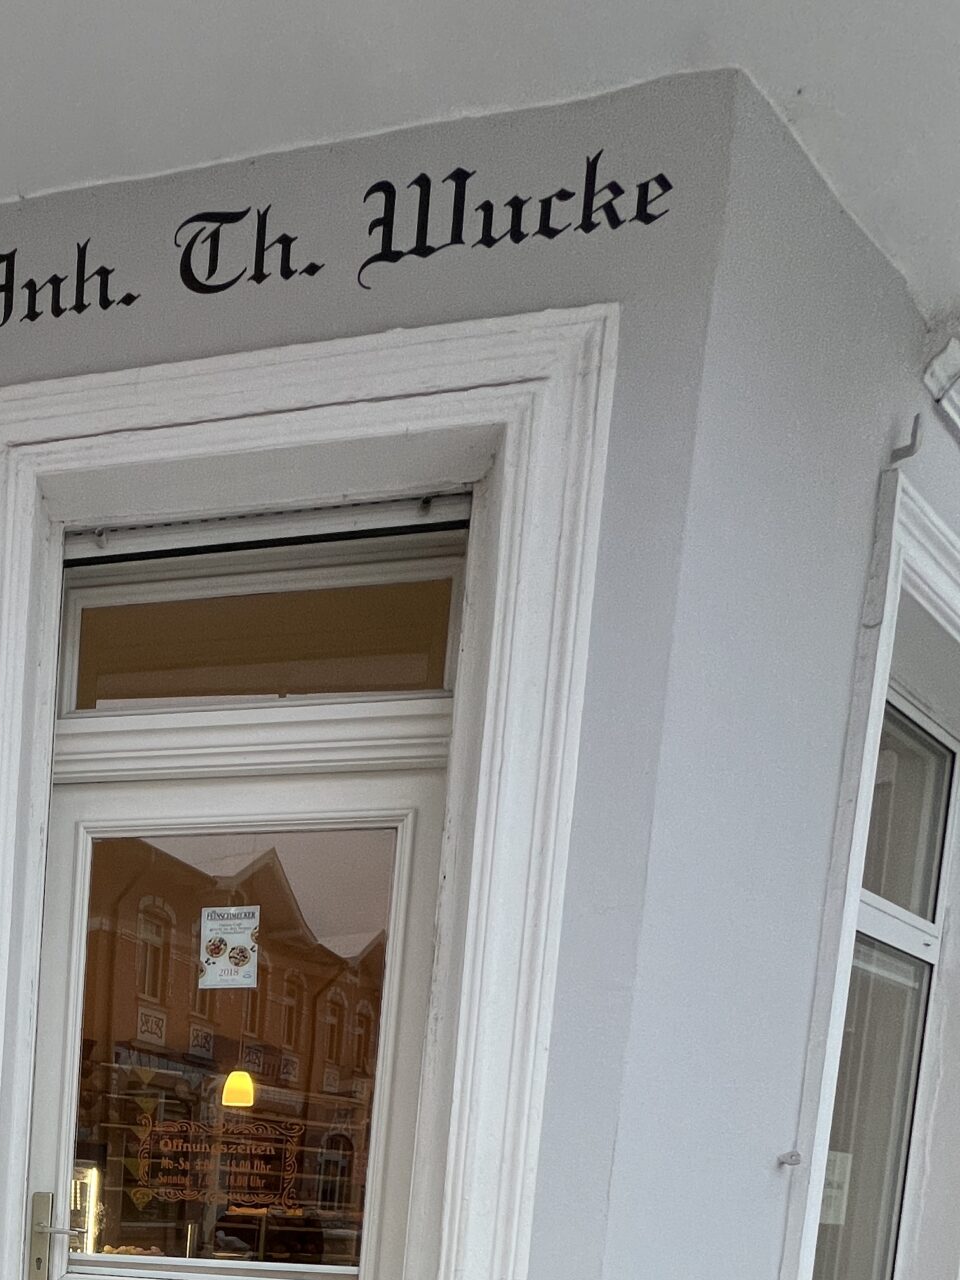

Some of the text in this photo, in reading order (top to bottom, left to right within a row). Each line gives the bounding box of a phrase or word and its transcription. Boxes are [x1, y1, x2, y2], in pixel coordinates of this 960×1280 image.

[174, 204, 325, 295] Th.
[357, 148, 674, 290] Wucke
[218, 968, 240, 977] 2018
